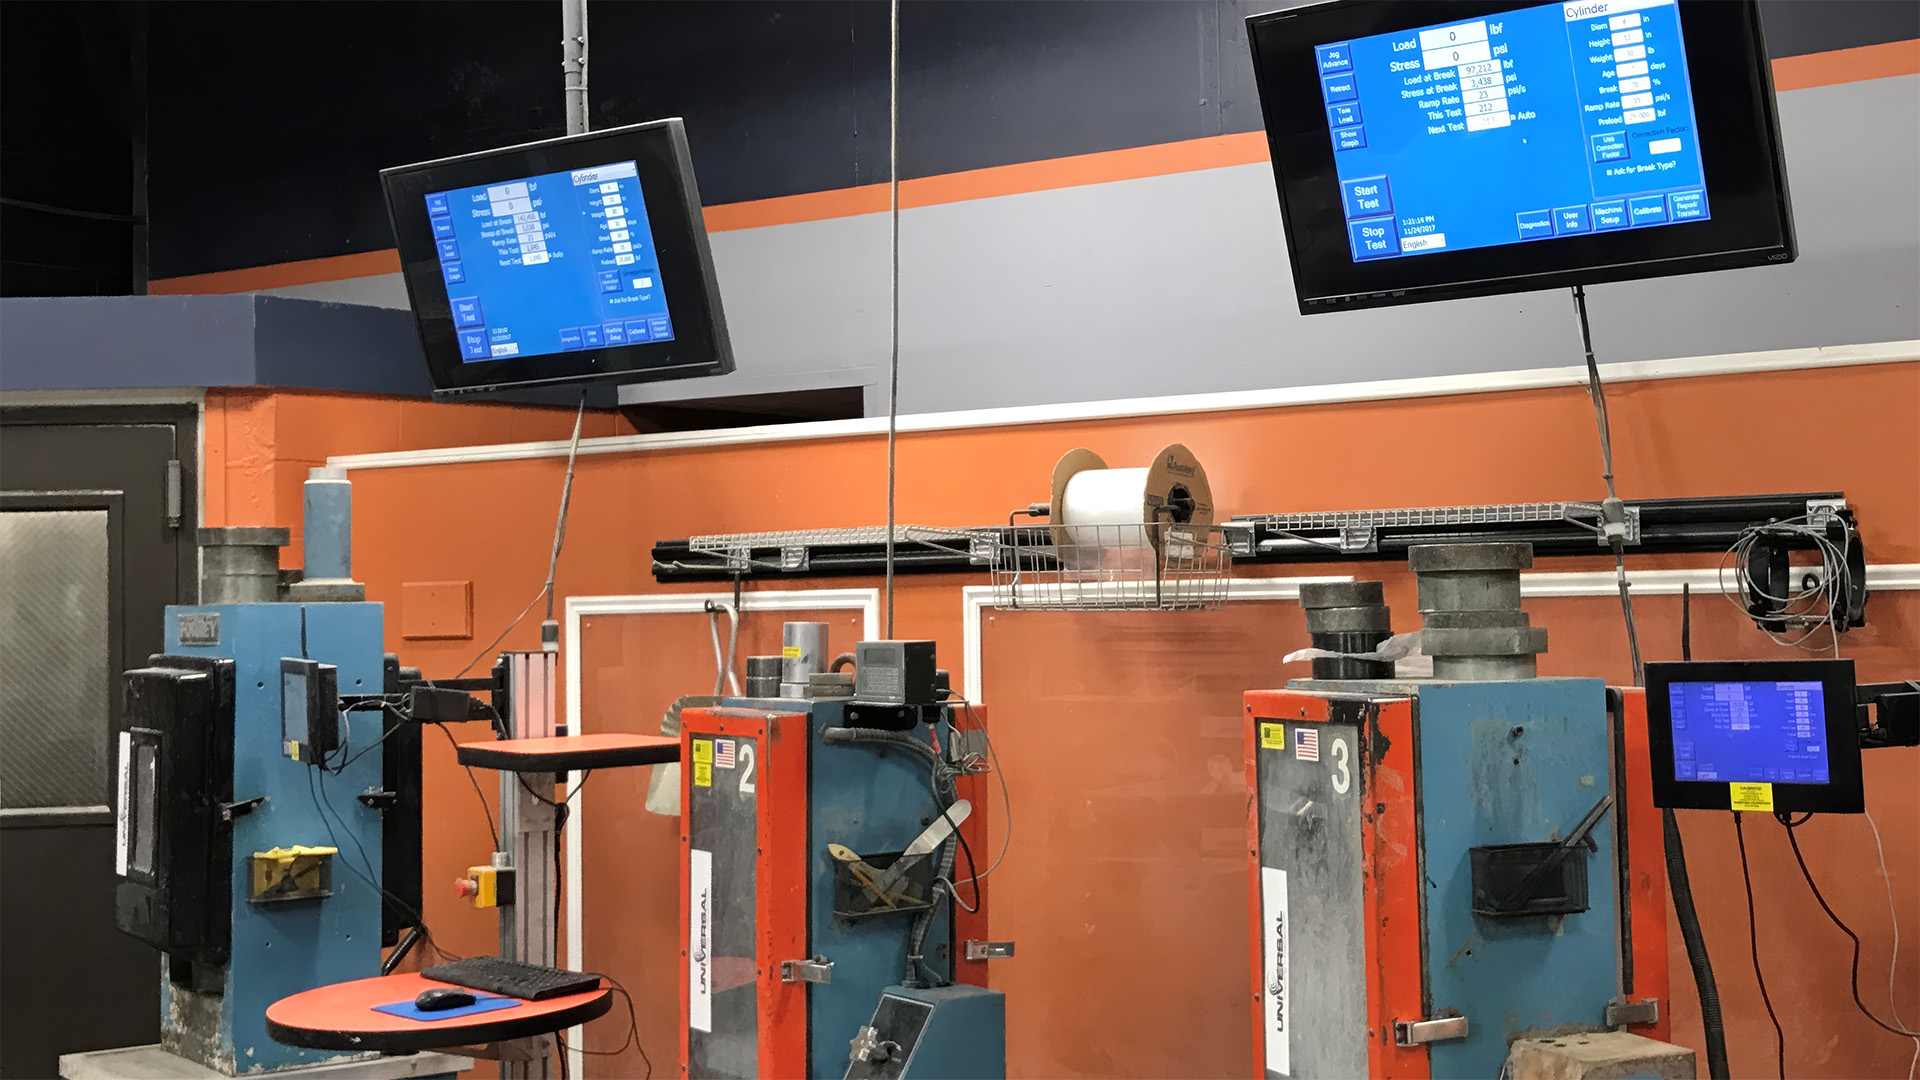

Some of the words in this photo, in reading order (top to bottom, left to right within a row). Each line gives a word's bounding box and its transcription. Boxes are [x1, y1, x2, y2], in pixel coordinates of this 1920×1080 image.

[1566, 3, 1608, 19] Cylinder
[1393, 39, 1416, 51] Load
[1450, 32, 1456, 41] 0
[1490, 23, 1503, 35] lbf
[1589, 38, 1610, 48] Height
[1323, 59, 1348, 68] Advance
[1390, 60, 1420, 72] Stress
[1453, 52, 1459, 60] 0
[1494, 44, 1508, 57] psi
[1589, 54, 1613, 63] Weight
[1404, 76, 1422, 85] Load
[1424, 74, 1432, 82] at
[1434, 70, 1456, 80] Break
[1466, 63, 1492, 75] 97,212
[1503, 60, 1514, 68] lbf
[1602, 70, 1615, 78] Age
[1650, 62, 1666, 70] days
[1401, 89, 1424, 99] Stress
[1436, 83, 1458, 93] Break
[1471, 77, 1492, 88] 3,438
[1506, 72, 1517, 83] psi
[1599, 85, 1618, 94] Break
[1419, 100, 1440, 110] Ramp
[1442, 96, 1460, 106] Rate
[1479, 90, 1488, 99] 23
[1508, 84, 1526, 97] psi/s
[1428, 111, 1443, 120] This
[1445, 108, 1462, 117] Test
[1479, 103, 1493, 112] 212
[1584, 103, 1603, 112] Ramp
[1428, 125, 1446, 135] Next
[1448, 122, 1464, 131] Test
[1518, 111, 1536, 120] Auto
[1632, 129, 1665, 139] Correction
[1626, 166, 1636, 174] for
[1637, 164, 1656, 173] Break
[1657, 161, 1676, 170] Type?
[1354, 185, 1377, 196] Start
[1358, 199, 1379, 210] Test
[1634, 206, 1662, 215] Calibrate
[1601, 216, 1619, 224] Setup
[1362, 227, 1385, 238] Stop
[1366, 240, 1386, 250] Test
[1402, 240, 1427, 249] English
[740, 744, 755, 793] 2
[1332, 738, 1350, 794] 3
[698, 888, 707, 994] UNIVERSAL
[1274, 910, 1284, 1032] UNIVERSAL
